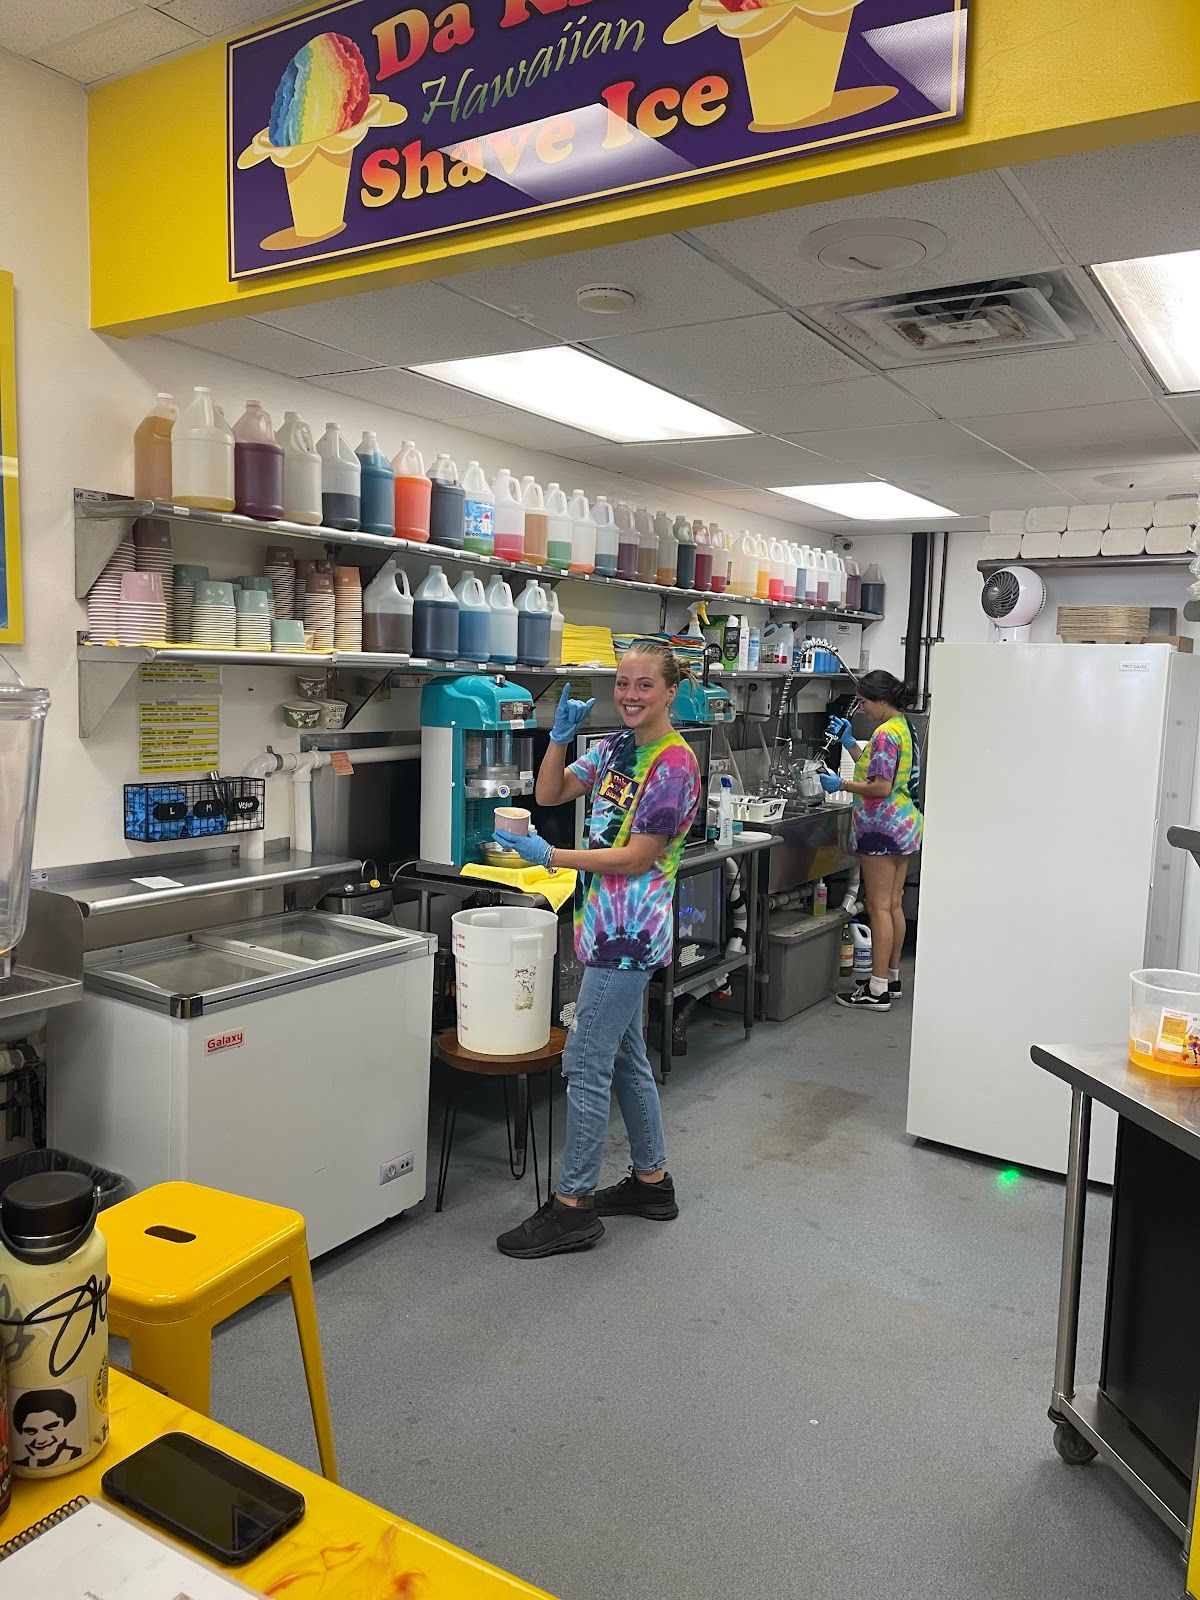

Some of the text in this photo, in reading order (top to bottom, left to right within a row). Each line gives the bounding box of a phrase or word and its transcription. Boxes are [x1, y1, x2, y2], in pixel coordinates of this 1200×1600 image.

[371, 2, 475, 81] Da
[421, 15, 646, 124] Hawaiian
[360, 74, 730, 209] Shave Ice
[169, 807, 176, 815] L
[206, 803, 213, 812] M
[207, 1032, 243, 1048] Galaxy
